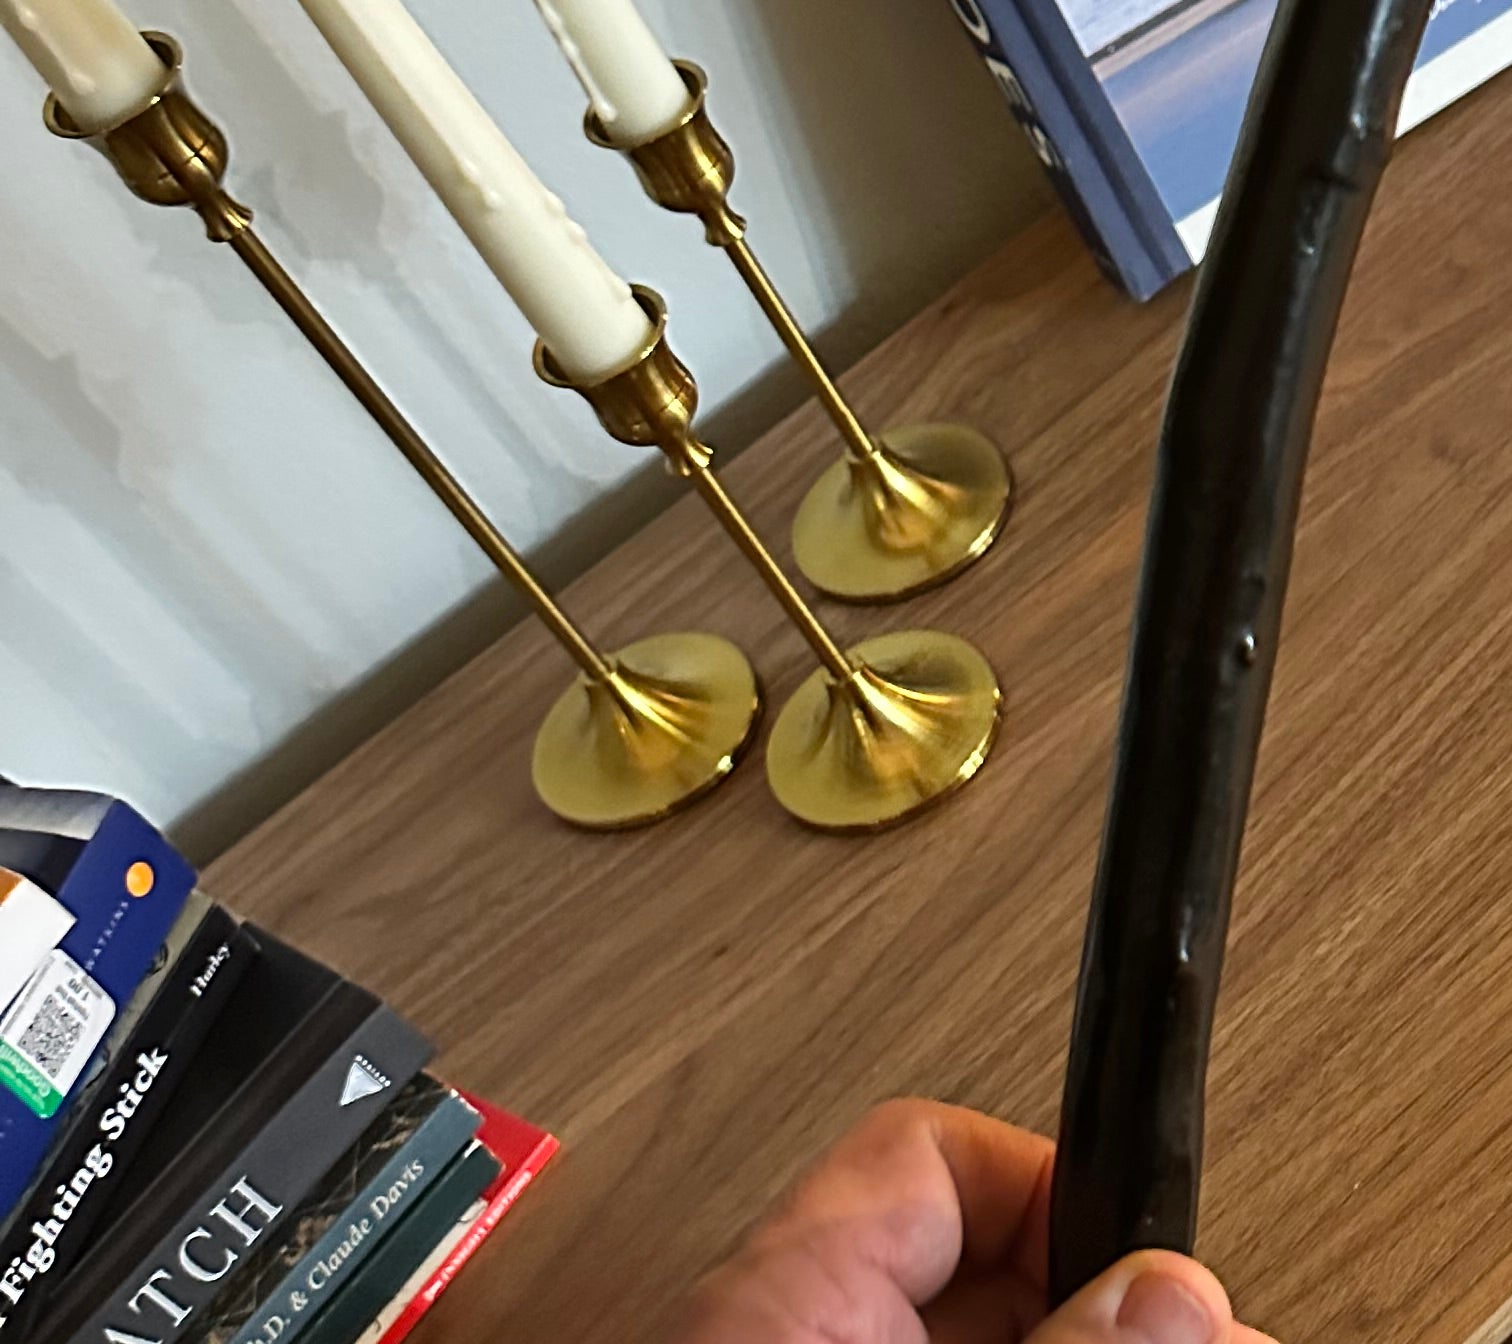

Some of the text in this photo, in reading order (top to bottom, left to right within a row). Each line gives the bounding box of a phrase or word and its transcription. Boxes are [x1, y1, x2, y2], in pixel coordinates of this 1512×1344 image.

[0, 1143, 114, 1306] Fighting
[100, 1047, 169, 1141] Stick
[290, 1290, 309, 1312] &
[308, 1216, 374, 1290] Claude
[369, 1158, 425, 1221] Davis
